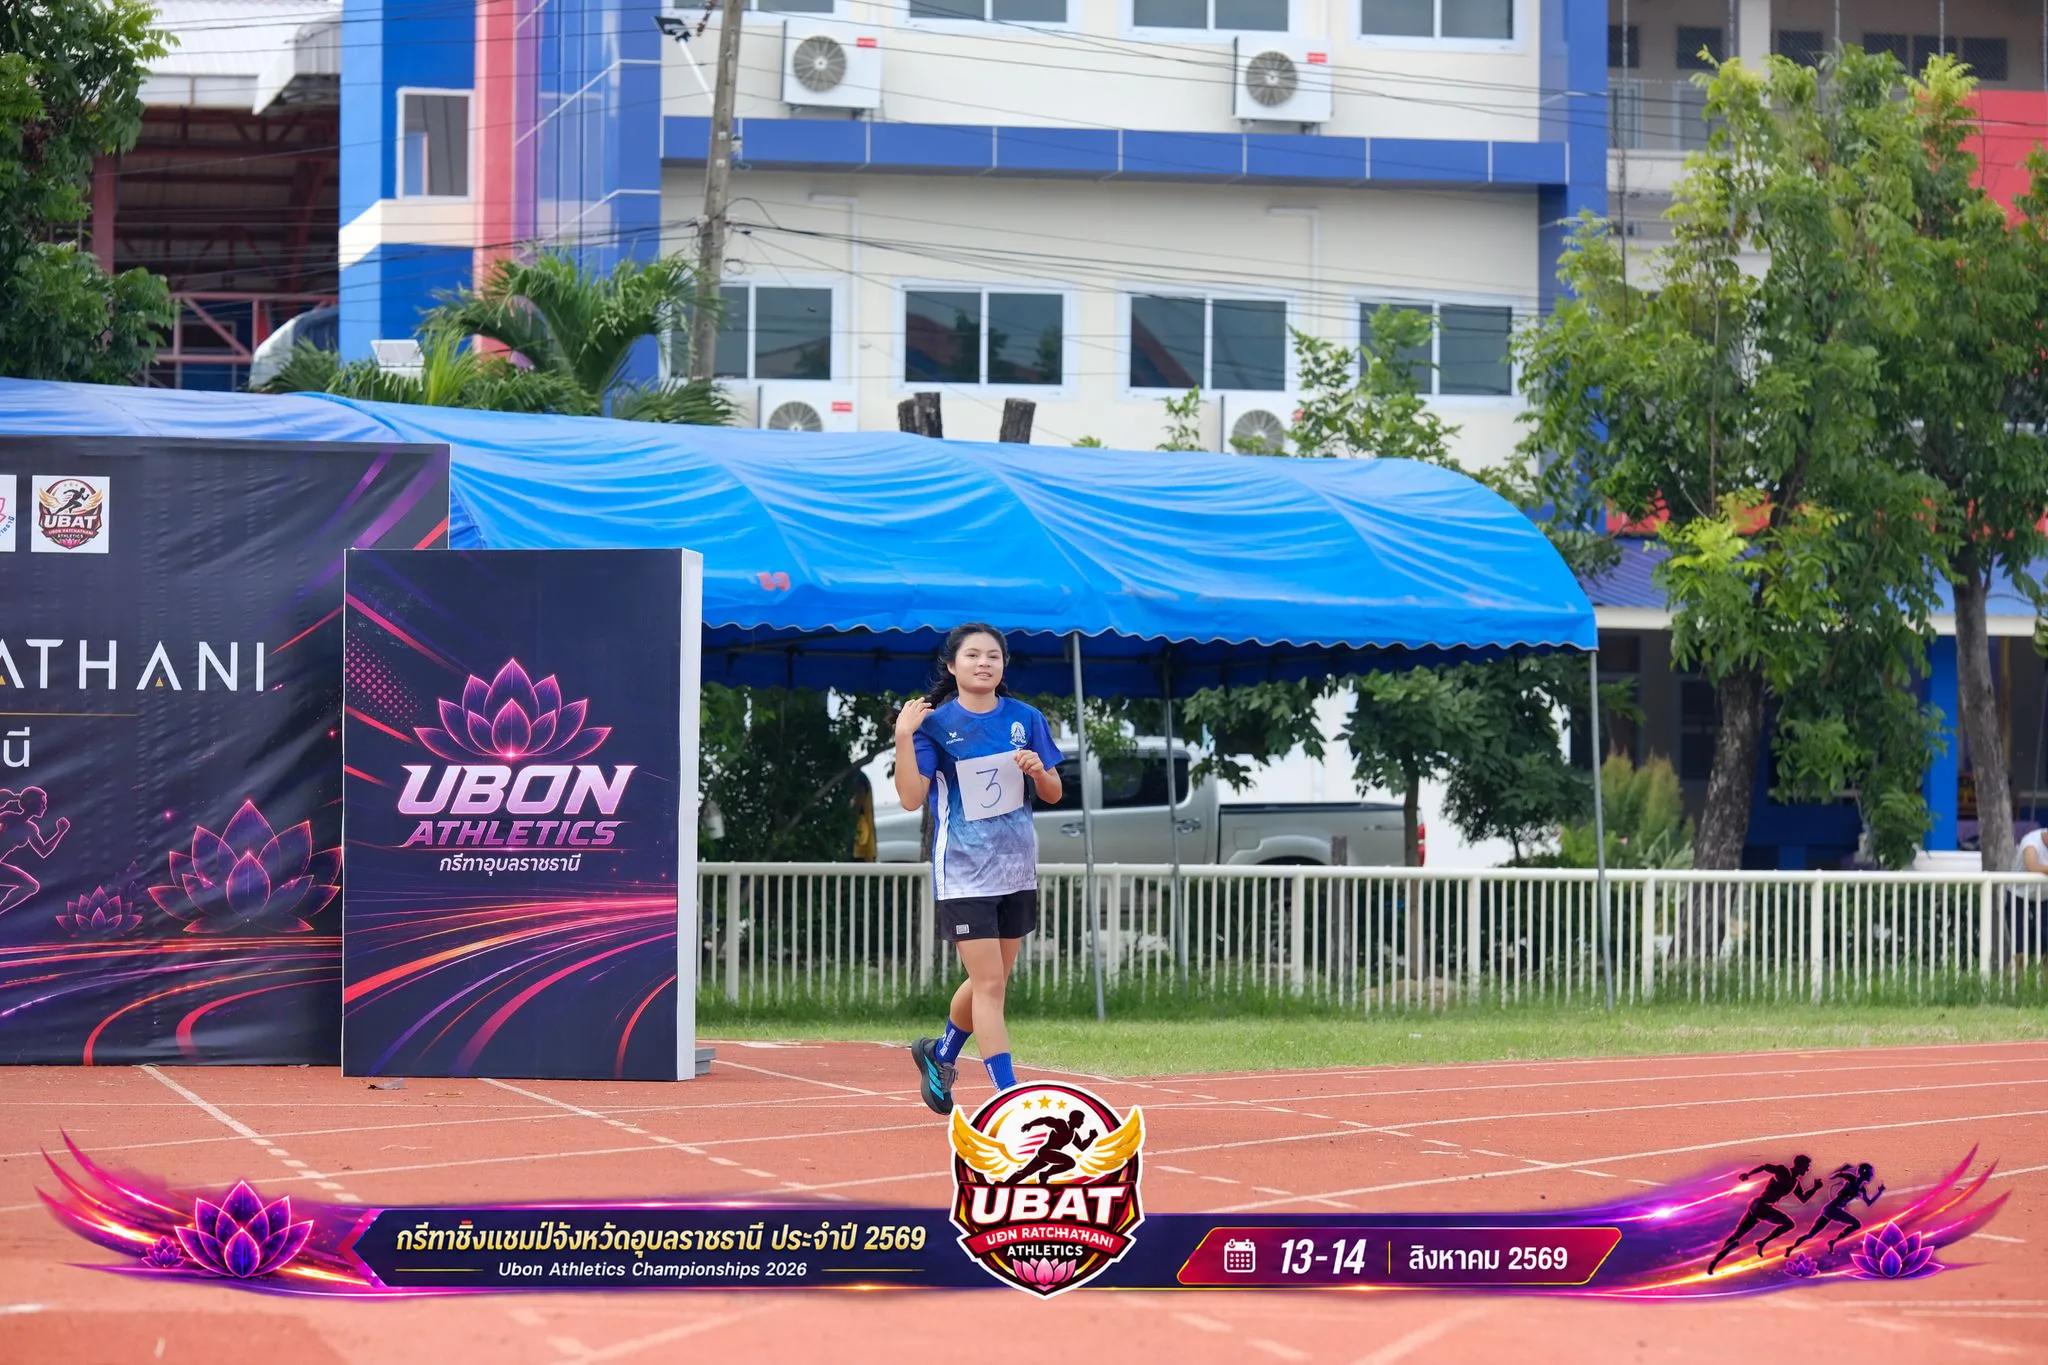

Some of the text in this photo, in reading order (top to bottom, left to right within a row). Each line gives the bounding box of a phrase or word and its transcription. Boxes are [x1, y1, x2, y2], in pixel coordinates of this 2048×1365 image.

[44, 515, 97, 529] UBAT
[397, 764, 638, 815] UBON
[975, 767, 1003, 809] 3
[403, 819, 628, 848] ATHLETICS
